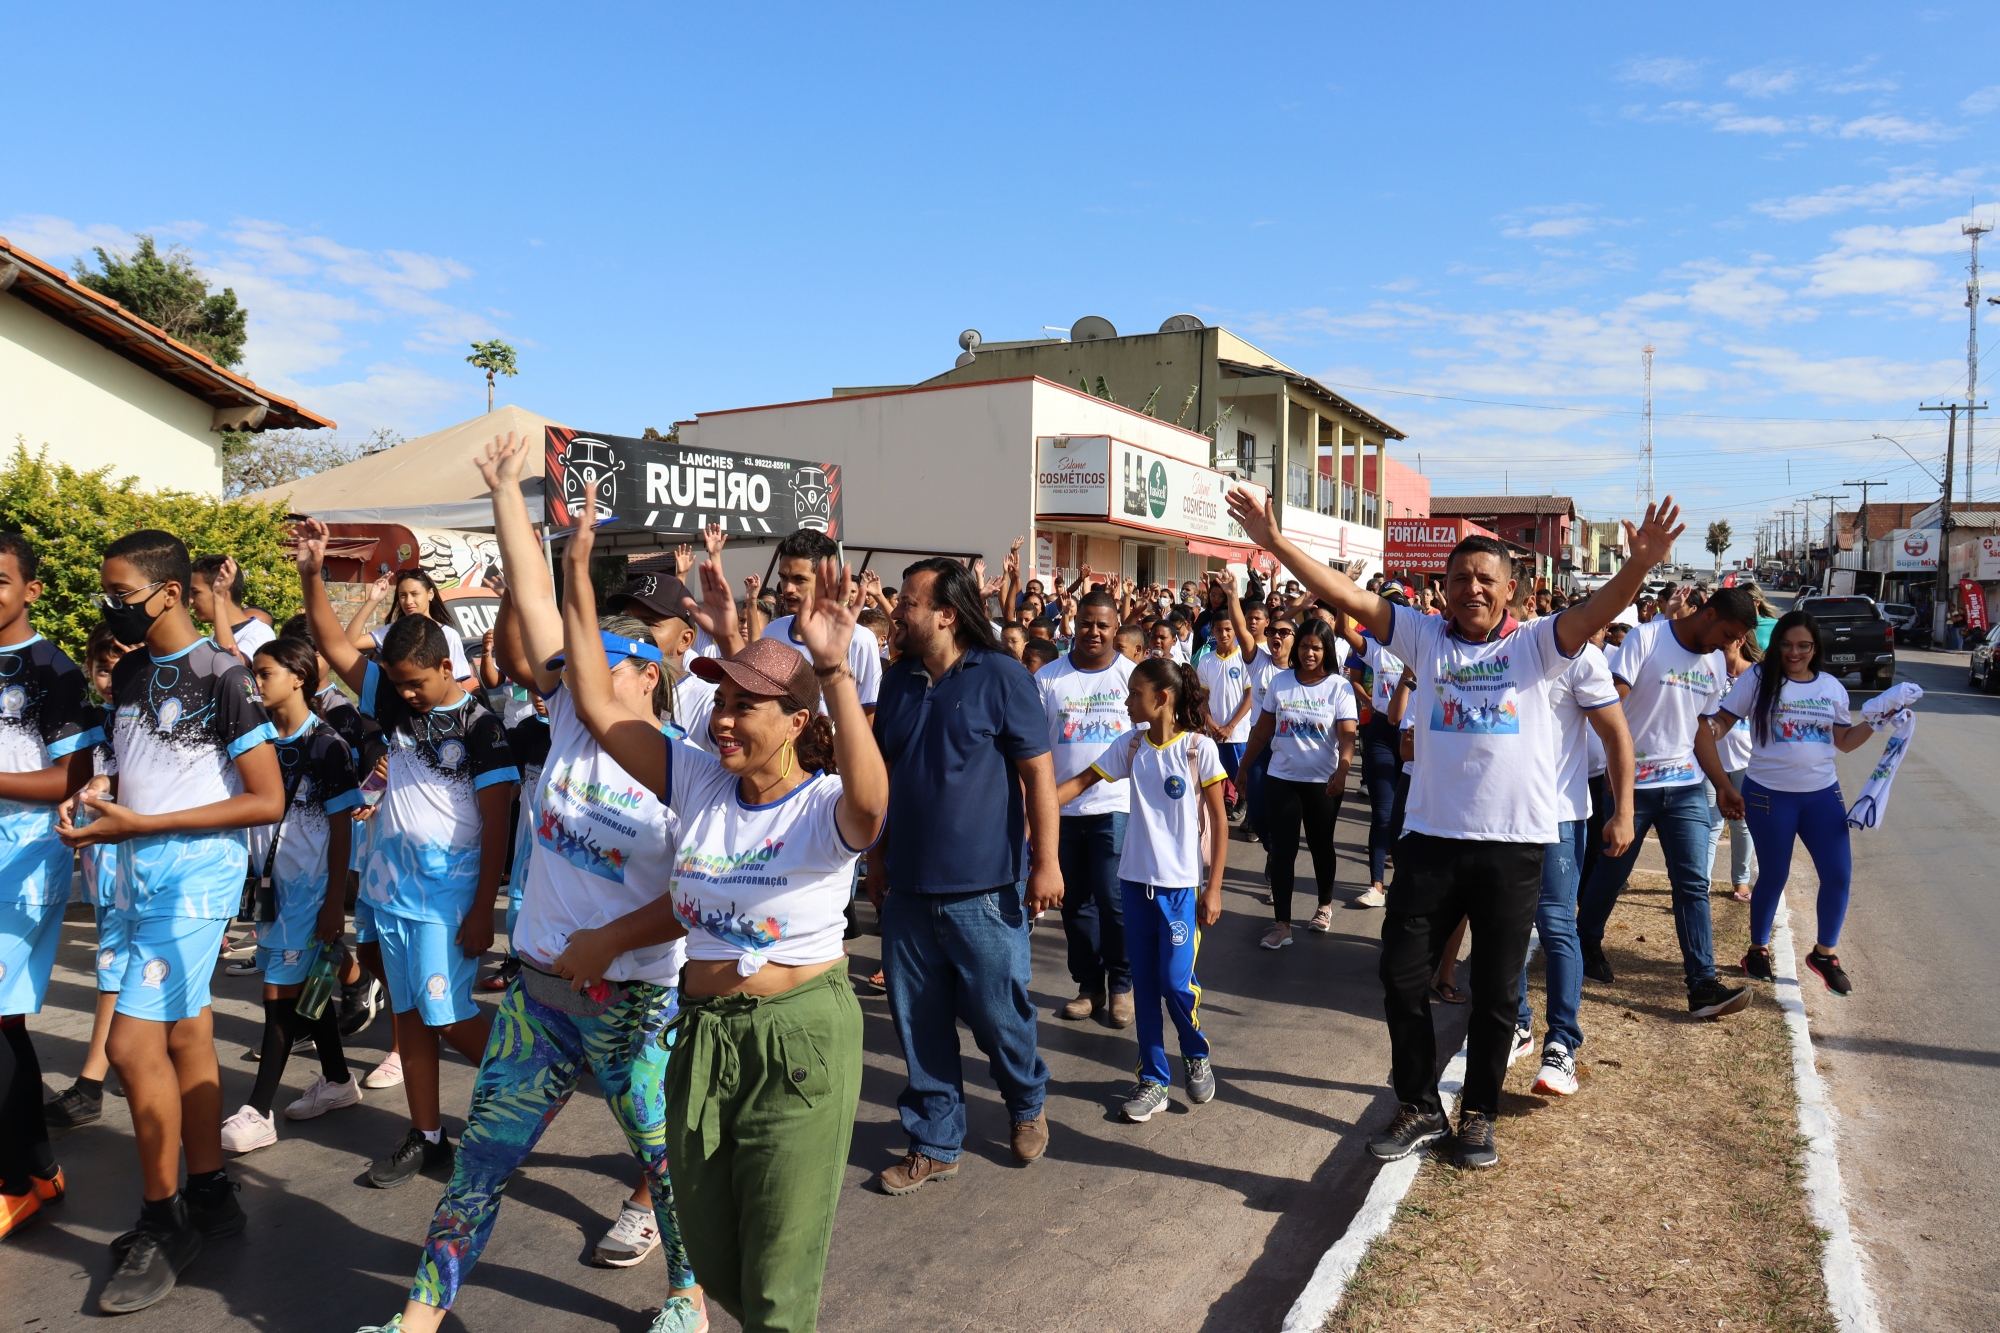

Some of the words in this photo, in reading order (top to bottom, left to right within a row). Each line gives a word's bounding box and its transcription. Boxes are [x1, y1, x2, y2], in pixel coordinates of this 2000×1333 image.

[680, 452, 734, 470] LANCHES
[1040, 470, 1105, 484] COSMÉTICOS
[646, 462, 771, 513] RUEIRO
[1387, 526, 1456, 543] FORTALEZA
[1387, 560, 1446, 568] 99259-9399
[1968, 594, 1980, 619] Miguel
[584, 809, 637, 838] TRANSFORMAÇÃO
[689, 856, 714, 870] LUGAR
[681, 870, 707, 881] MUNDO
[707, 876, 718, 885] EM
[720, 875, 788, 888] TRANSFORMAÇÃO
